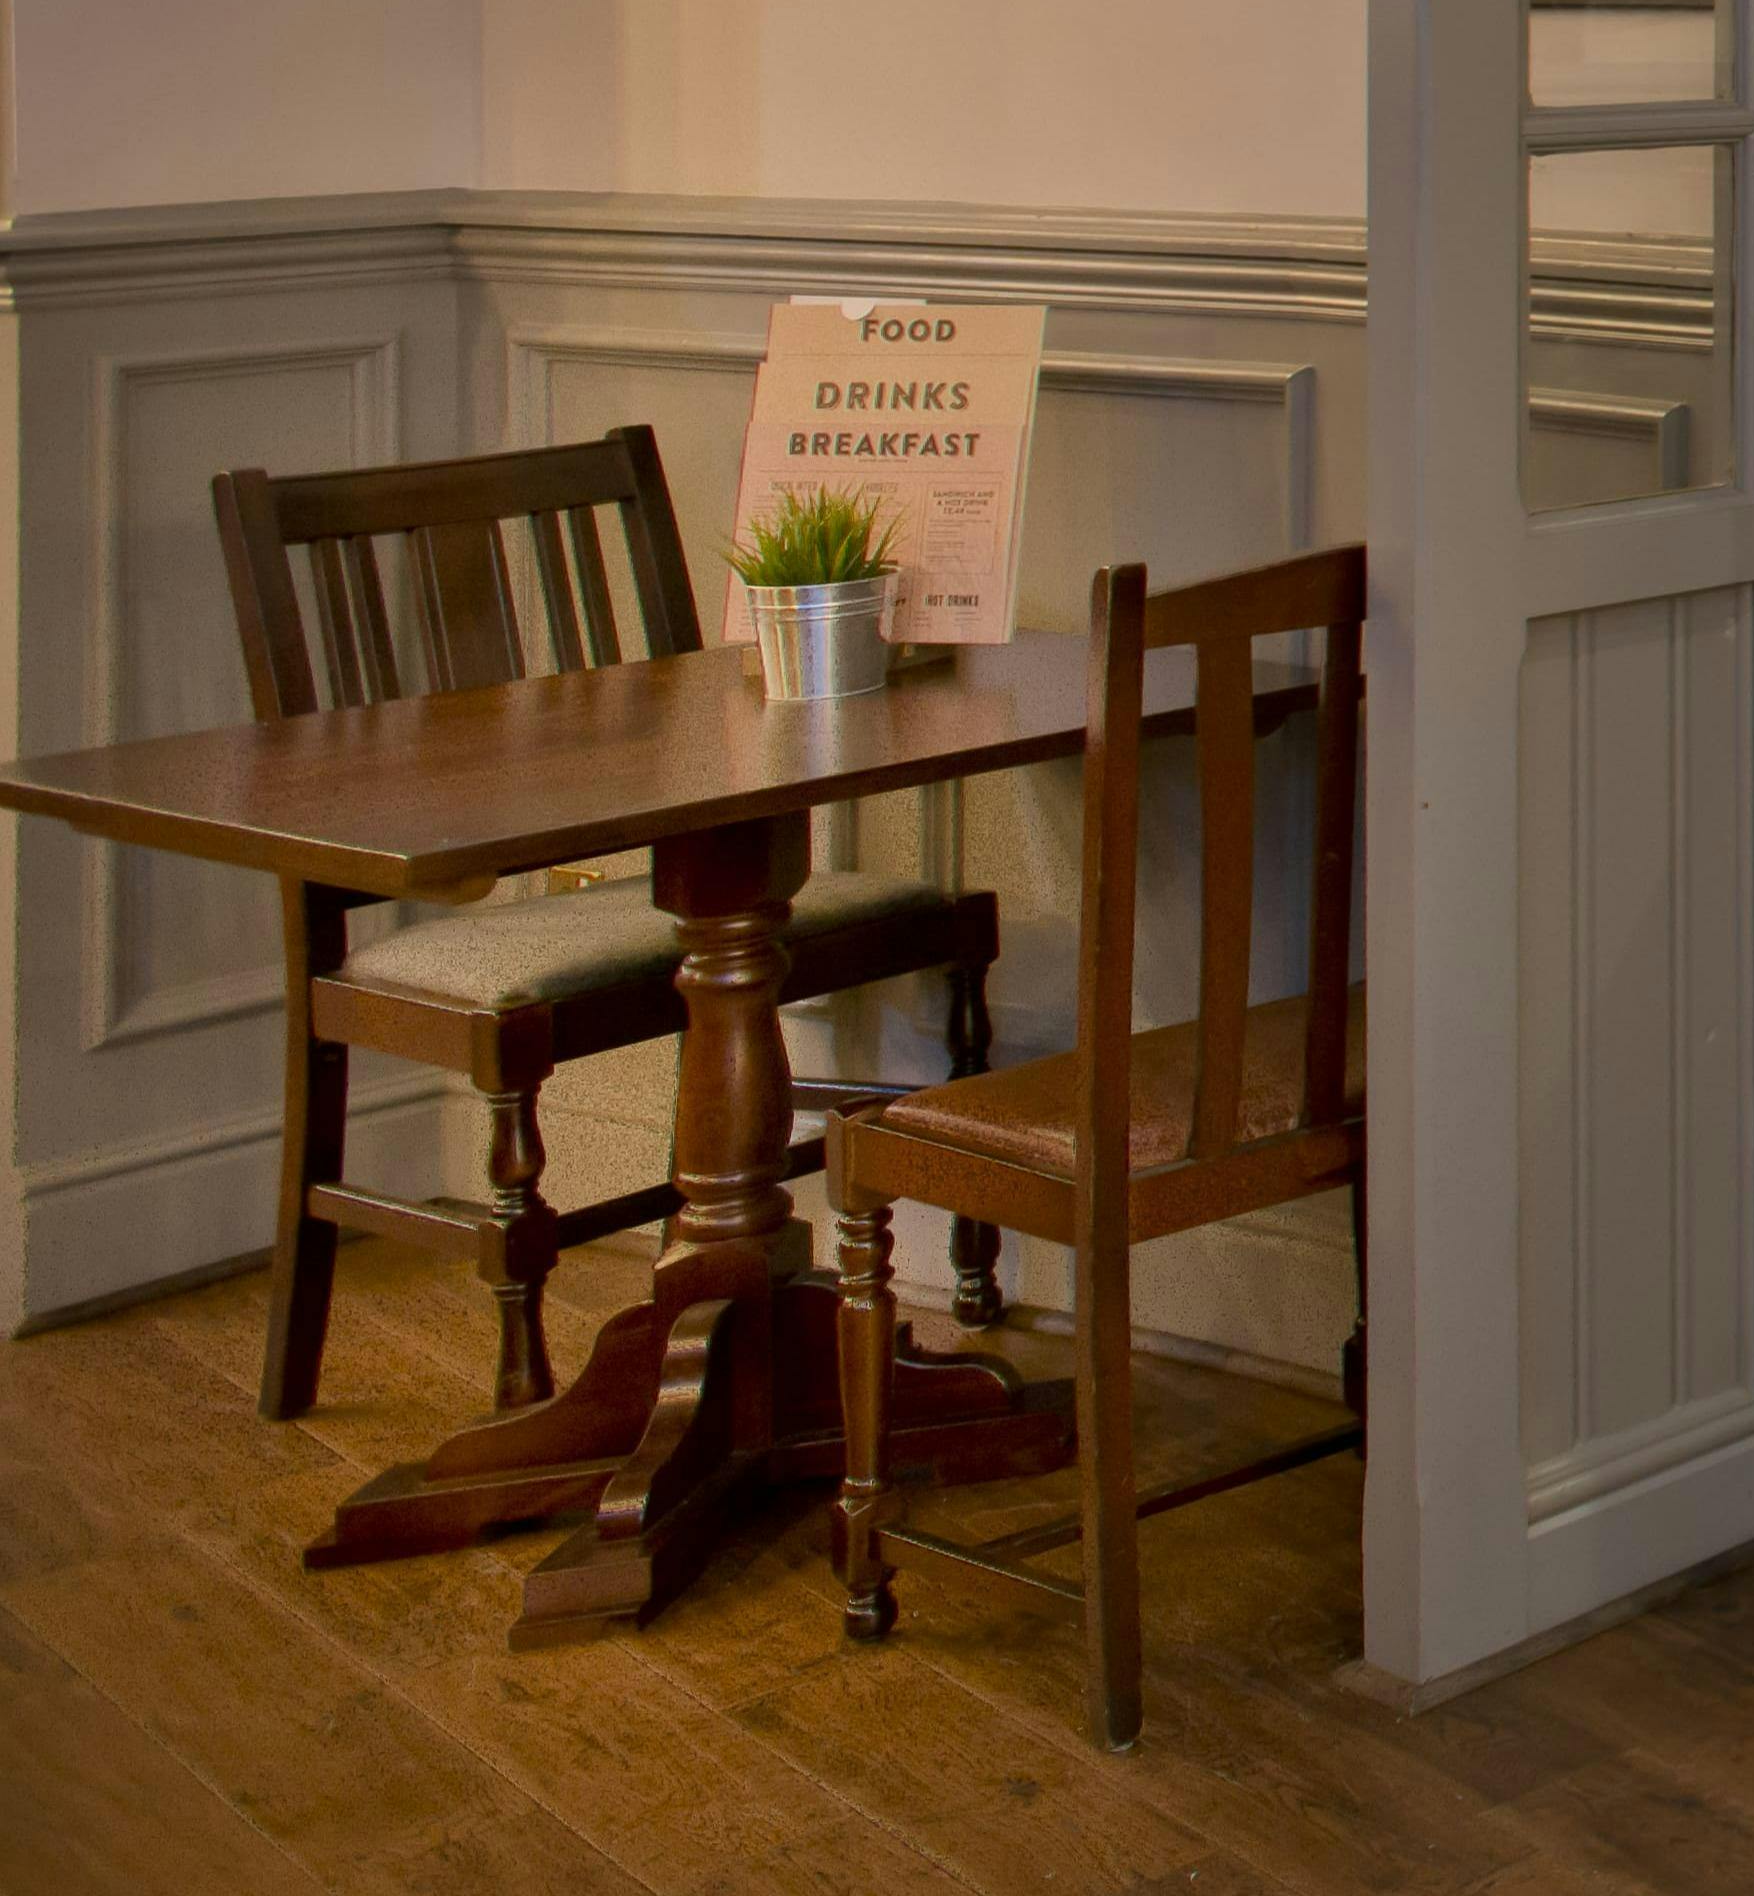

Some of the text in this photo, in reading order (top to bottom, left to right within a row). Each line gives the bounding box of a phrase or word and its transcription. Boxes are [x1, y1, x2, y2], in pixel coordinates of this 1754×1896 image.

[860, 318, 957, 343] FOOD
[815, 381, 972, 411] DRINKS
[788, 432, 981, 457] BREAKFAST
